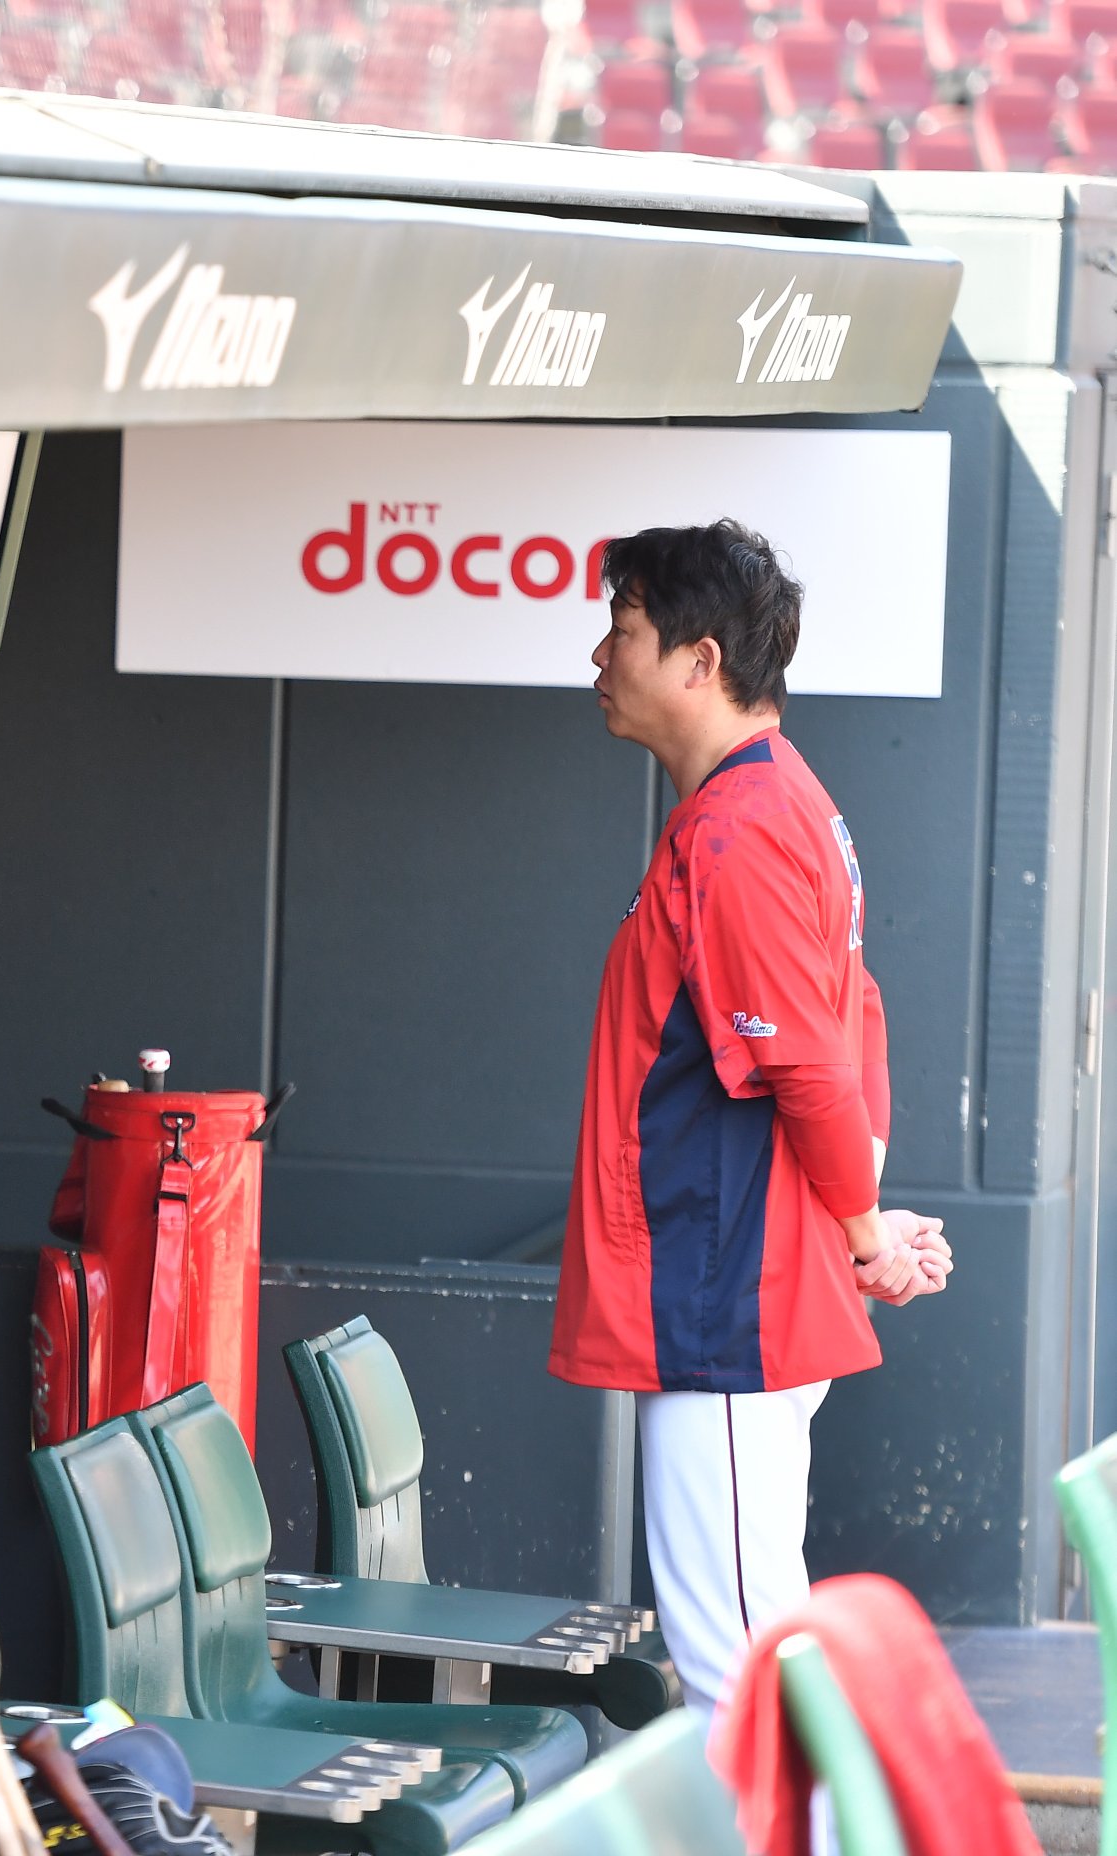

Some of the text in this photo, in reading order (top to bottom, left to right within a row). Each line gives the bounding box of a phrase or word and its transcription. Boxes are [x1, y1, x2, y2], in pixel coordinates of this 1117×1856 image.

[489, 282, 607, 387] Mizuno
[756, 293, 852, 384] Mizuno
[301, 501, 619, 601] doco
[379, 502, 441, 523] NTT
